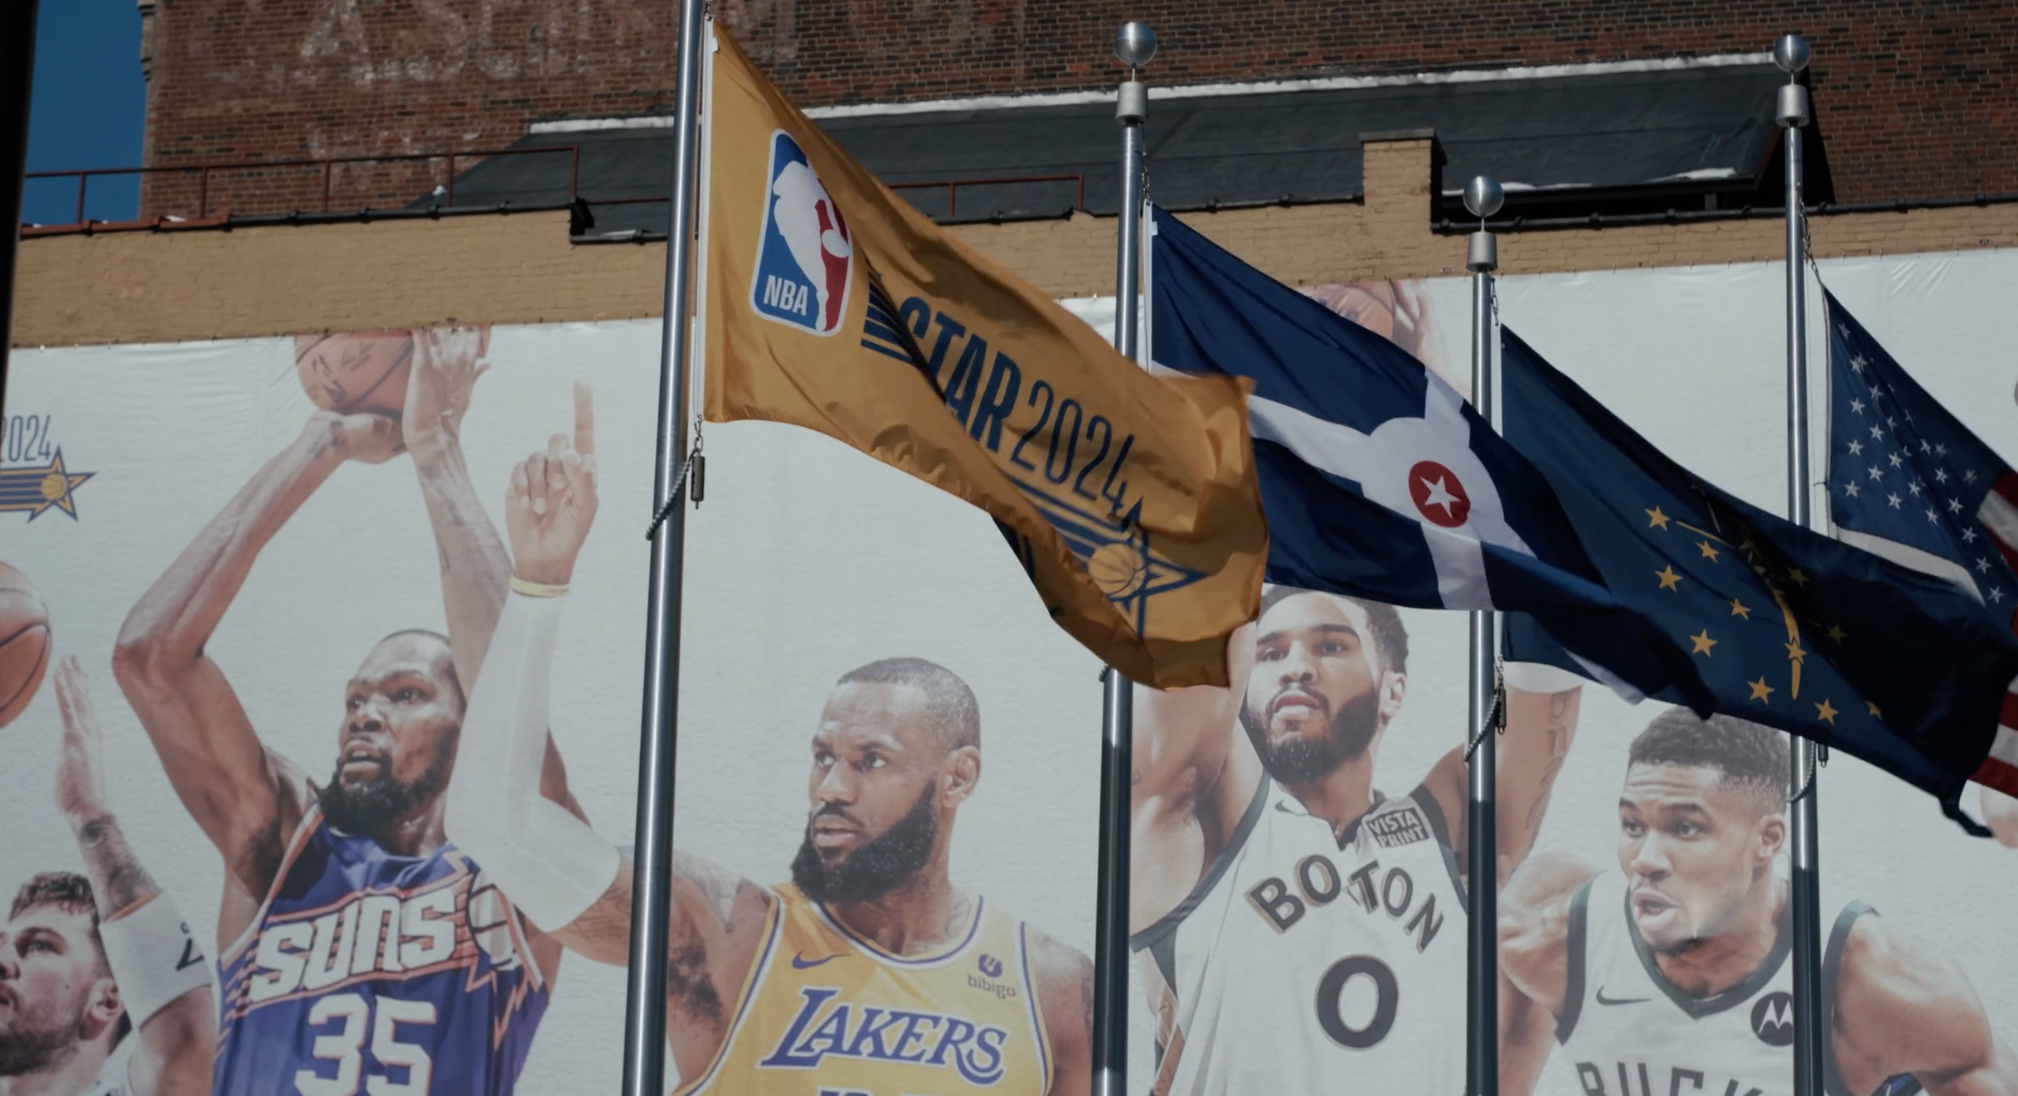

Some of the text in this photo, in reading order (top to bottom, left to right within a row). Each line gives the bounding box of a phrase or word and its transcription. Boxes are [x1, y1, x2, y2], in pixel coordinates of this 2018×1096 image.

[763, 274, 809, 316] NBA
[1010, 379, 1135, 516] 2024
[1368, 810, 1420, 835] VISTA
[1377, 826, 1425, 848] PRINT
[248, 887, 459, 1005] SUNS
[1245, 853, 1445, 954] BOTON
[967, 973, 1017, 1000] bibigo
[293, 992, 438, 1096] 35
[757, 987, 1009, 1086] LAKERS
